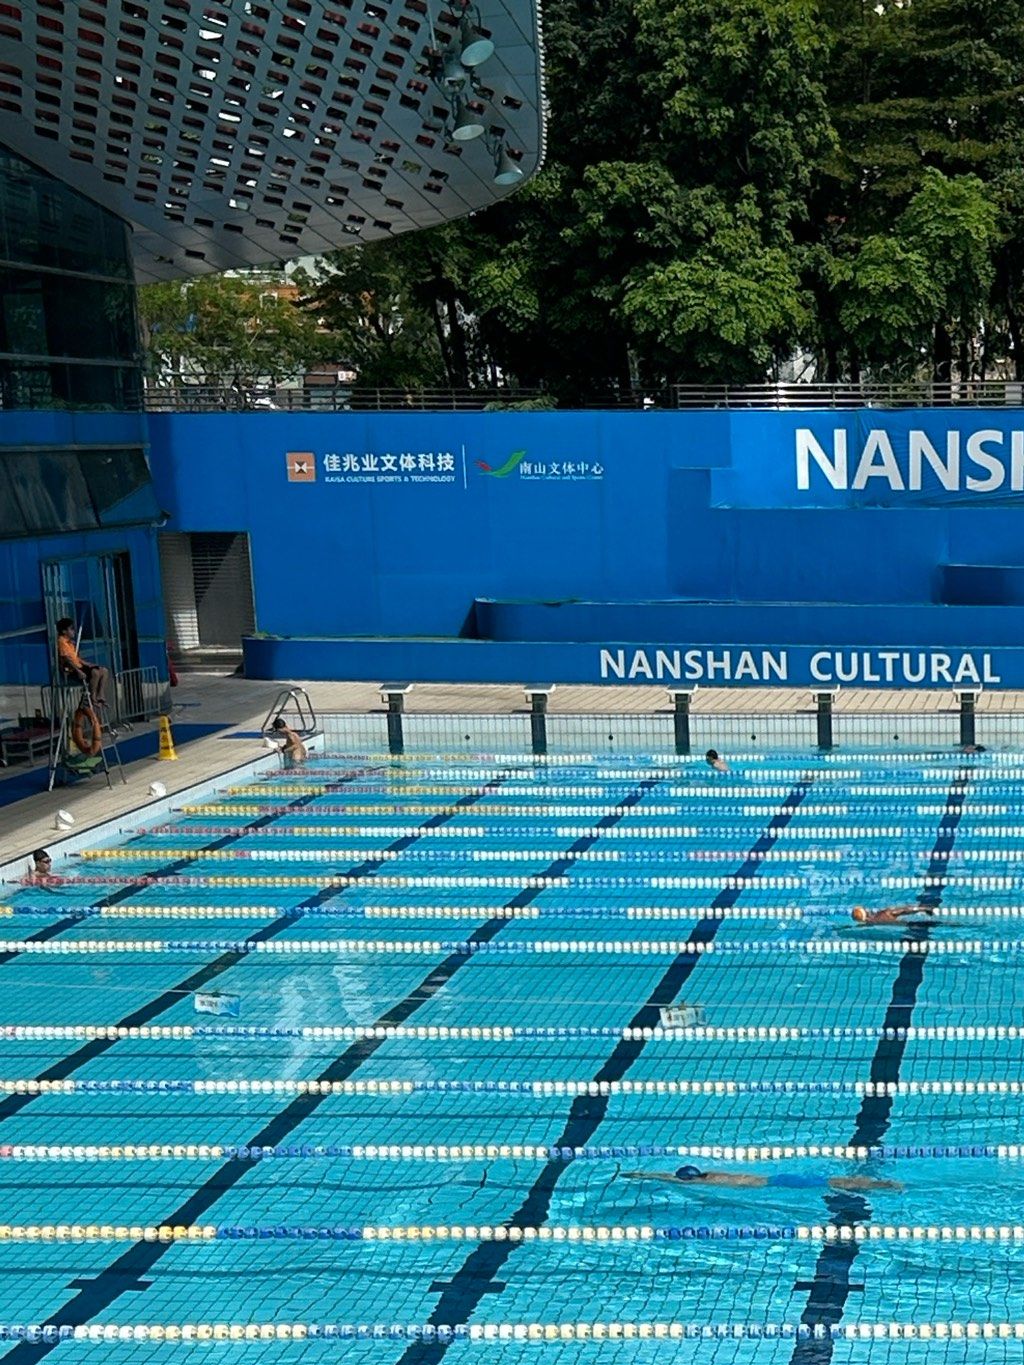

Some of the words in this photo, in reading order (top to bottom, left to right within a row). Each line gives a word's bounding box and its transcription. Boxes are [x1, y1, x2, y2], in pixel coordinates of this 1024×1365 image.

[323, 452, 455, 472] 佳兆业文体科技
[519, 461, 604, 475] 南山文体中心
[600, 649, 788, 680] NANSHAN
[809, 652, 1001, 683] CULTURAL
